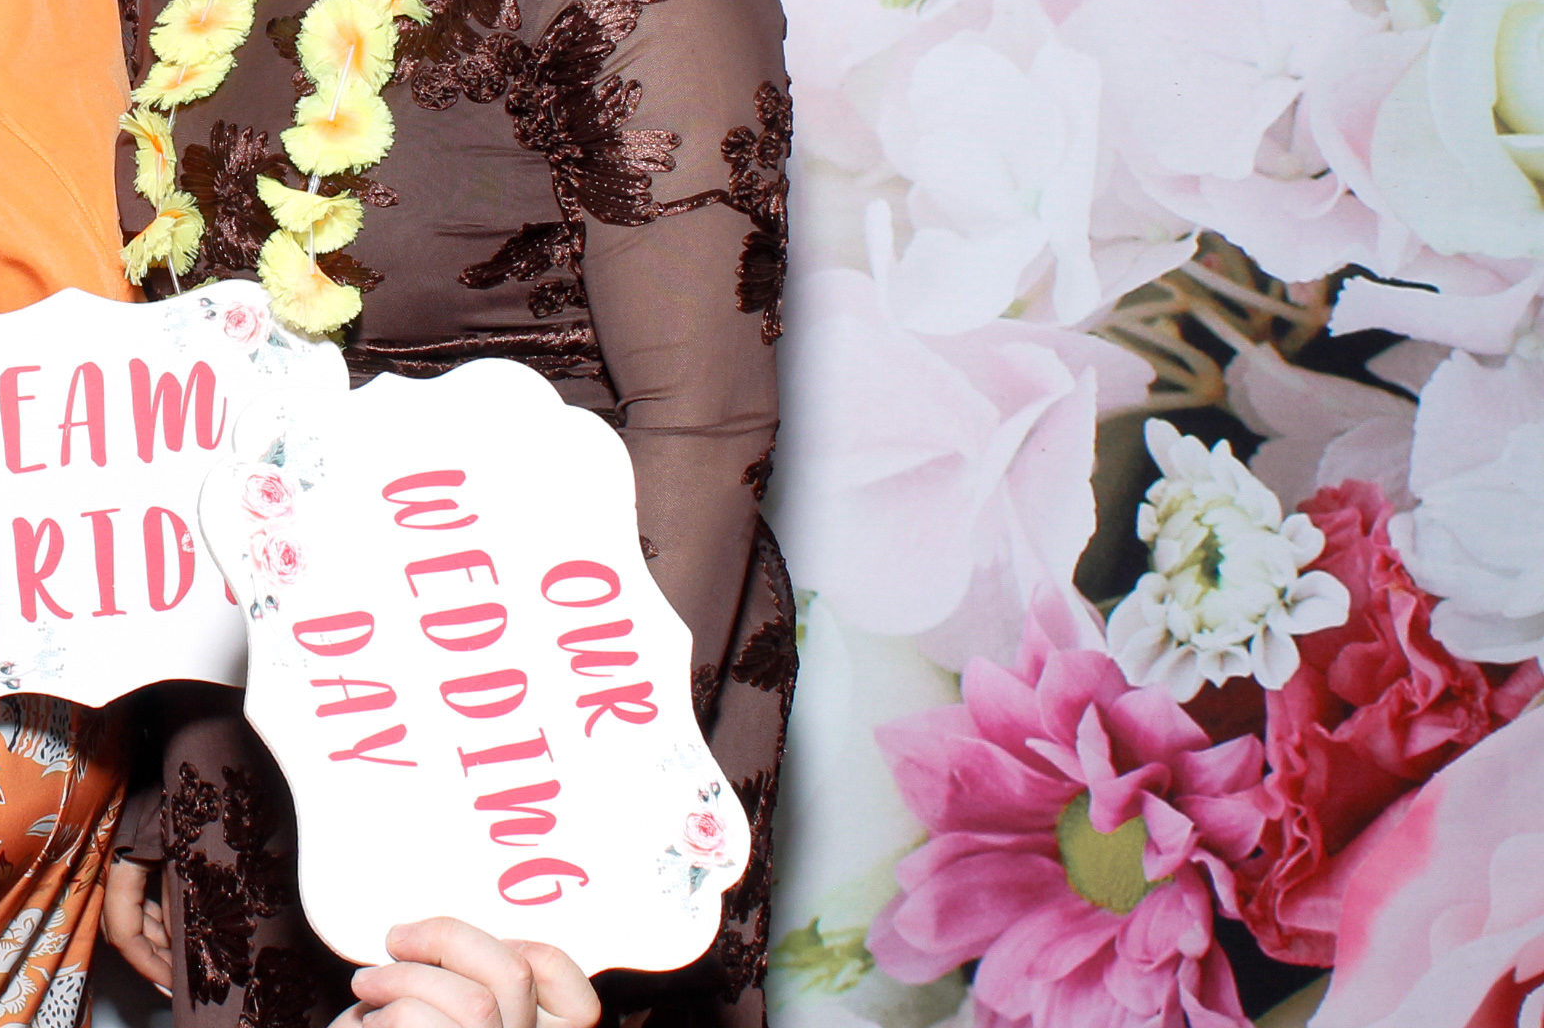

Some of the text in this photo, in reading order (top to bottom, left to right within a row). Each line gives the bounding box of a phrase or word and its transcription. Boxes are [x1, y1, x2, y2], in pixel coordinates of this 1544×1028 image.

[292, 610, 418, 767] DAY
[382, 470, 589, 906] WEDDING
[541, 560, 658, 737] OUR
